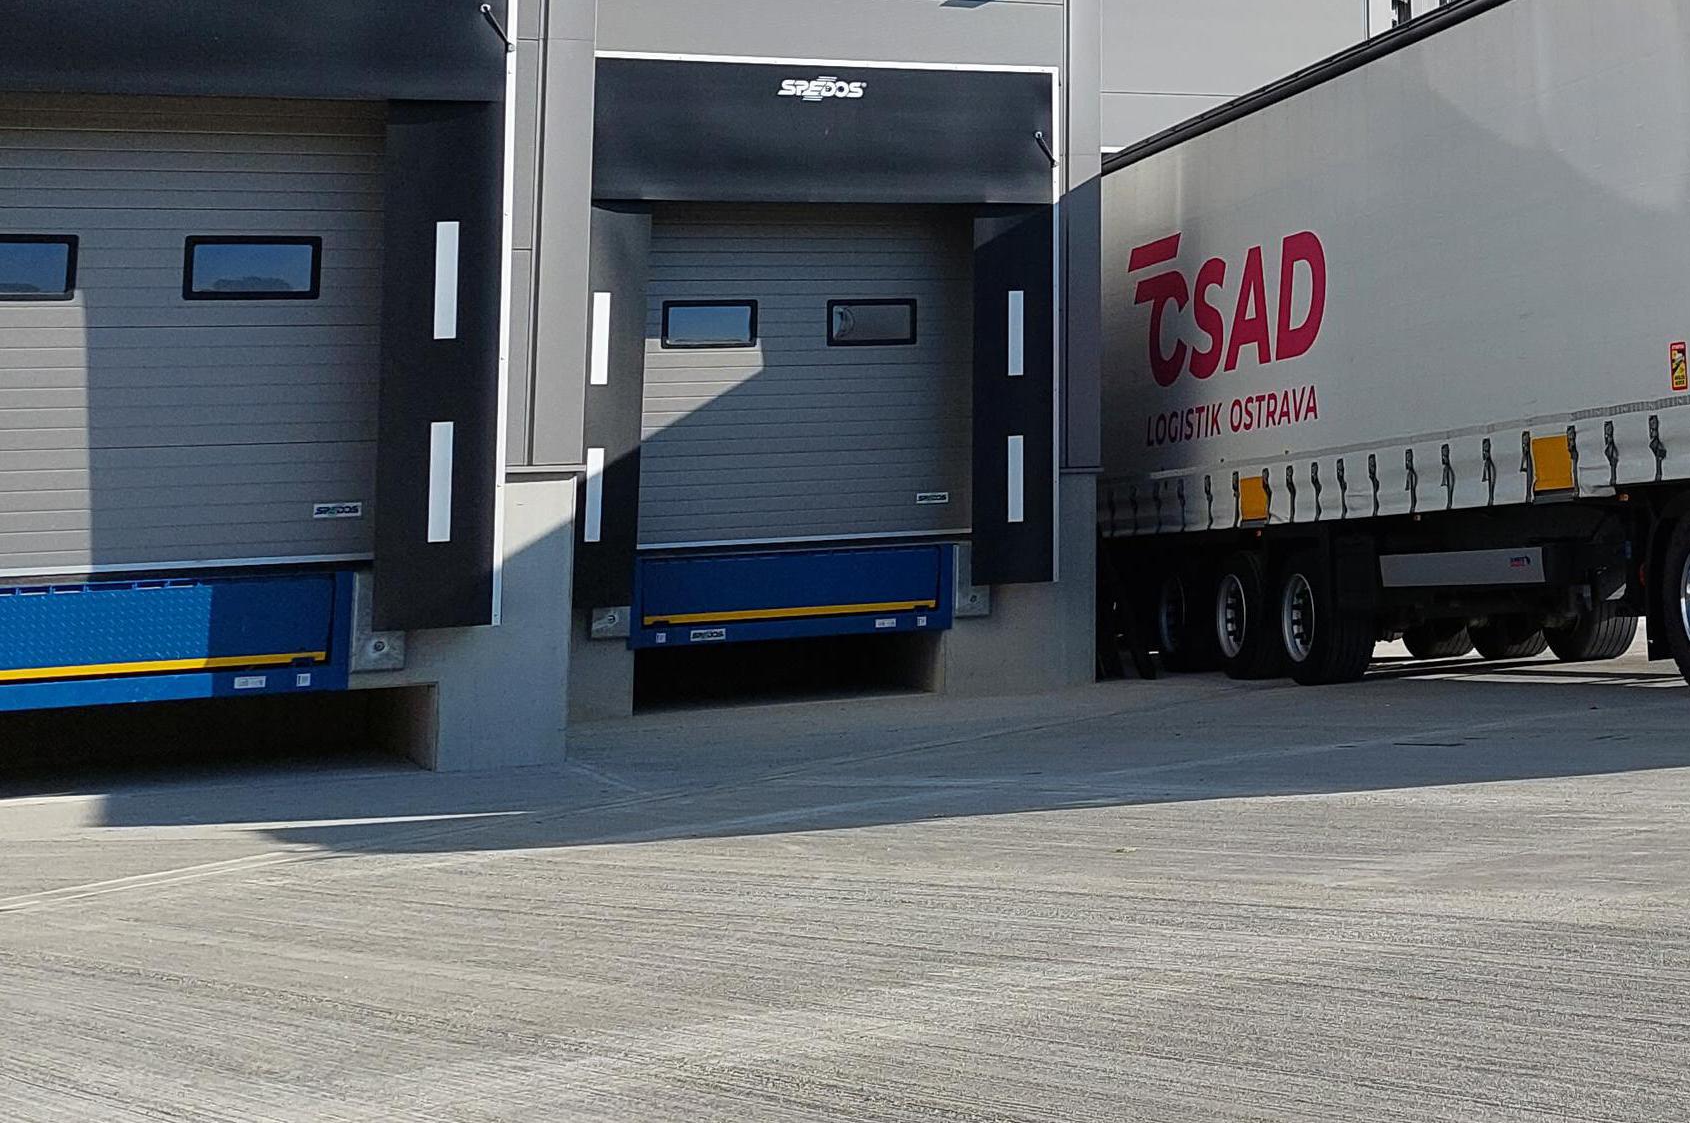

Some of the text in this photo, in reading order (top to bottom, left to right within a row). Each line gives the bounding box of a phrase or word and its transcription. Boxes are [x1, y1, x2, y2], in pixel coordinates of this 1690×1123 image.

[777, 78, 865, 99] SPEDOS
[1146, 385, 1318, 447] LOGISTIK OSTRAVA
